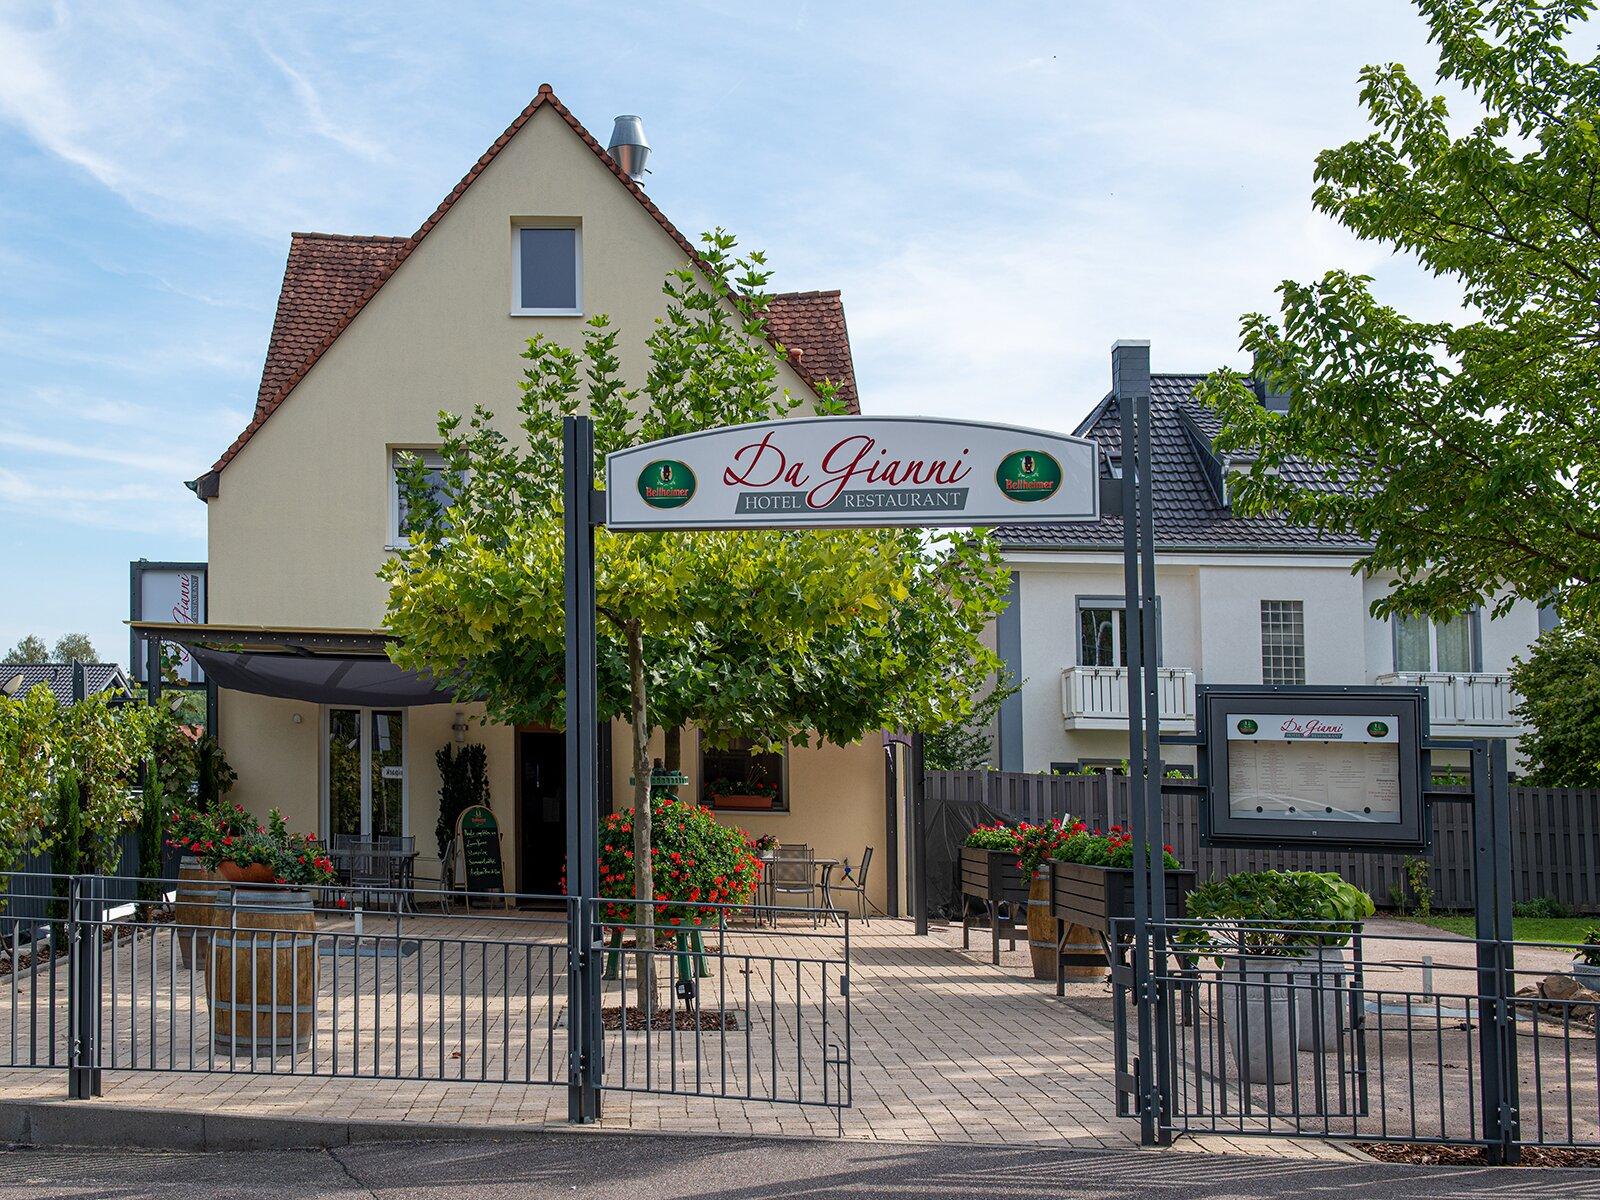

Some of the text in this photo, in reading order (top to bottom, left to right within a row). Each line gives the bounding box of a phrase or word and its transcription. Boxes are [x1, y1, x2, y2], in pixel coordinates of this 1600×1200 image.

[723, 431, 972, 509] Da Gianni
[646, 486, 690, 498] Bellheimer
[1005, 478, 1054, 490] Bellheimer
[745, 492, 961, 510] HOTEL RESTAURANT
[1280, 717, 1344, 737] Da Gianni
